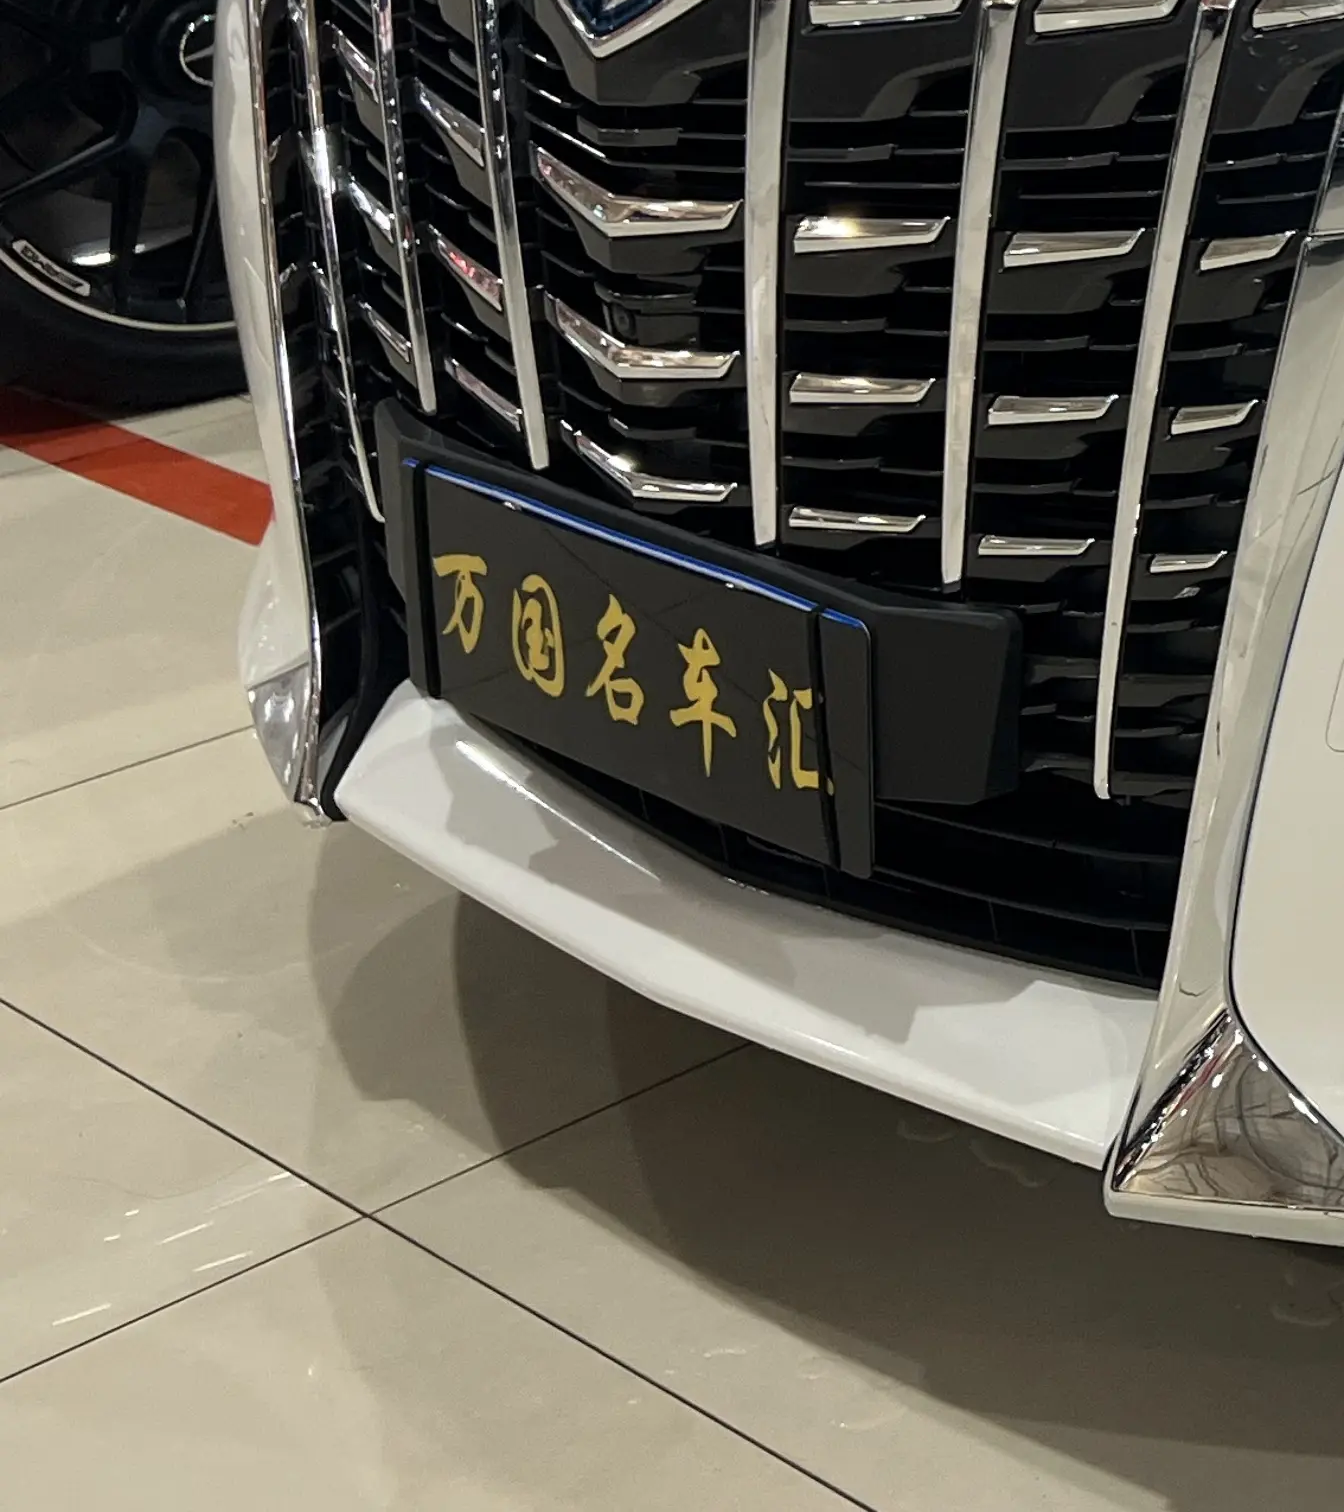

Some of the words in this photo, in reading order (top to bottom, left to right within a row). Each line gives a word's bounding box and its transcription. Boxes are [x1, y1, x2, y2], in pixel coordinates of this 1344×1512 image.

[432, 552, 835, 795] 万国名车汇
